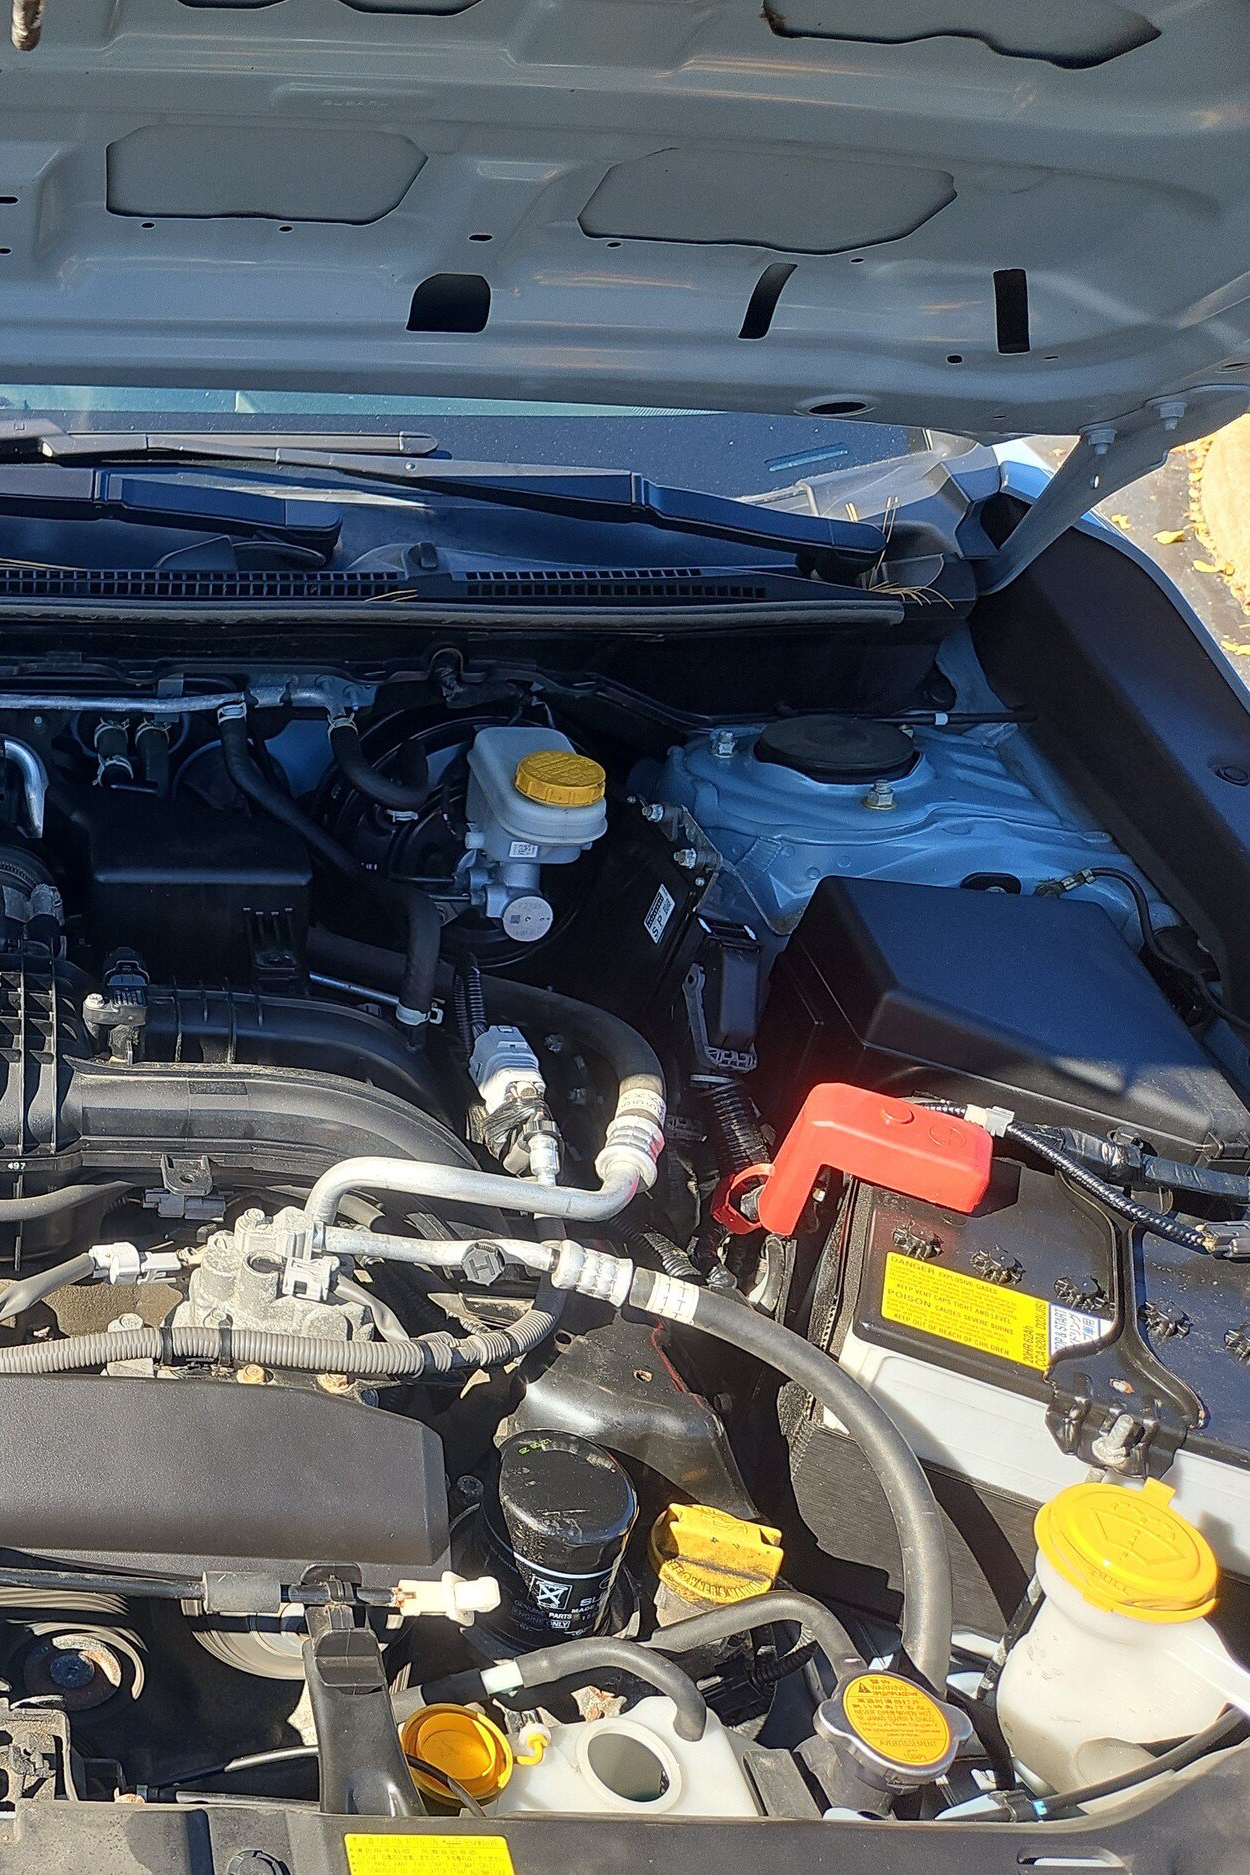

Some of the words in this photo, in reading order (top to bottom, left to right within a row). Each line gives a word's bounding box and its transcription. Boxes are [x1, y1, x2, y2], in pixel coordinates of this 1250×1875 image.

[469, 1254, 495, 1279] H
[890, 1255, 934, 1274] DANGER
[938, 1271, 972, 1287] EXPLOSIVE
[975, 1283, 997, 1295] GASES
[887, 1287, 931, 1308] POISON
[934, 1304, 961, 1318] CAUSES
[963, 1313, 987, 1326] SEVERE
[990, 1322, 1013, 1335] BURNS
[896, 1282, 913, 1292] KEEP
[914, 1288, 931, 1298] VENT
[933, 1294, 951, 1305] CAPS
[953, 1301, 972, 1311] TIGHT
[974, 1307, 989, 1317] AND
[991, 1312, 1011, 1324] LEVEL
[893, 1312, 910, 1322] KEEP
[912, 1318, 925, 1328] OUT
[928, 1323, 936, 1331] OF
[938, 1327, 961, 1339] REACH
[963, 1335, 971, 1343] OF
[974, 1339, 1009, 1355] CHILDREN
[1054, 1308, 1068, 1332] START
[547, 1620, 570, 1628] ONLY
[548, 1612, 572, 1620] PARTS
